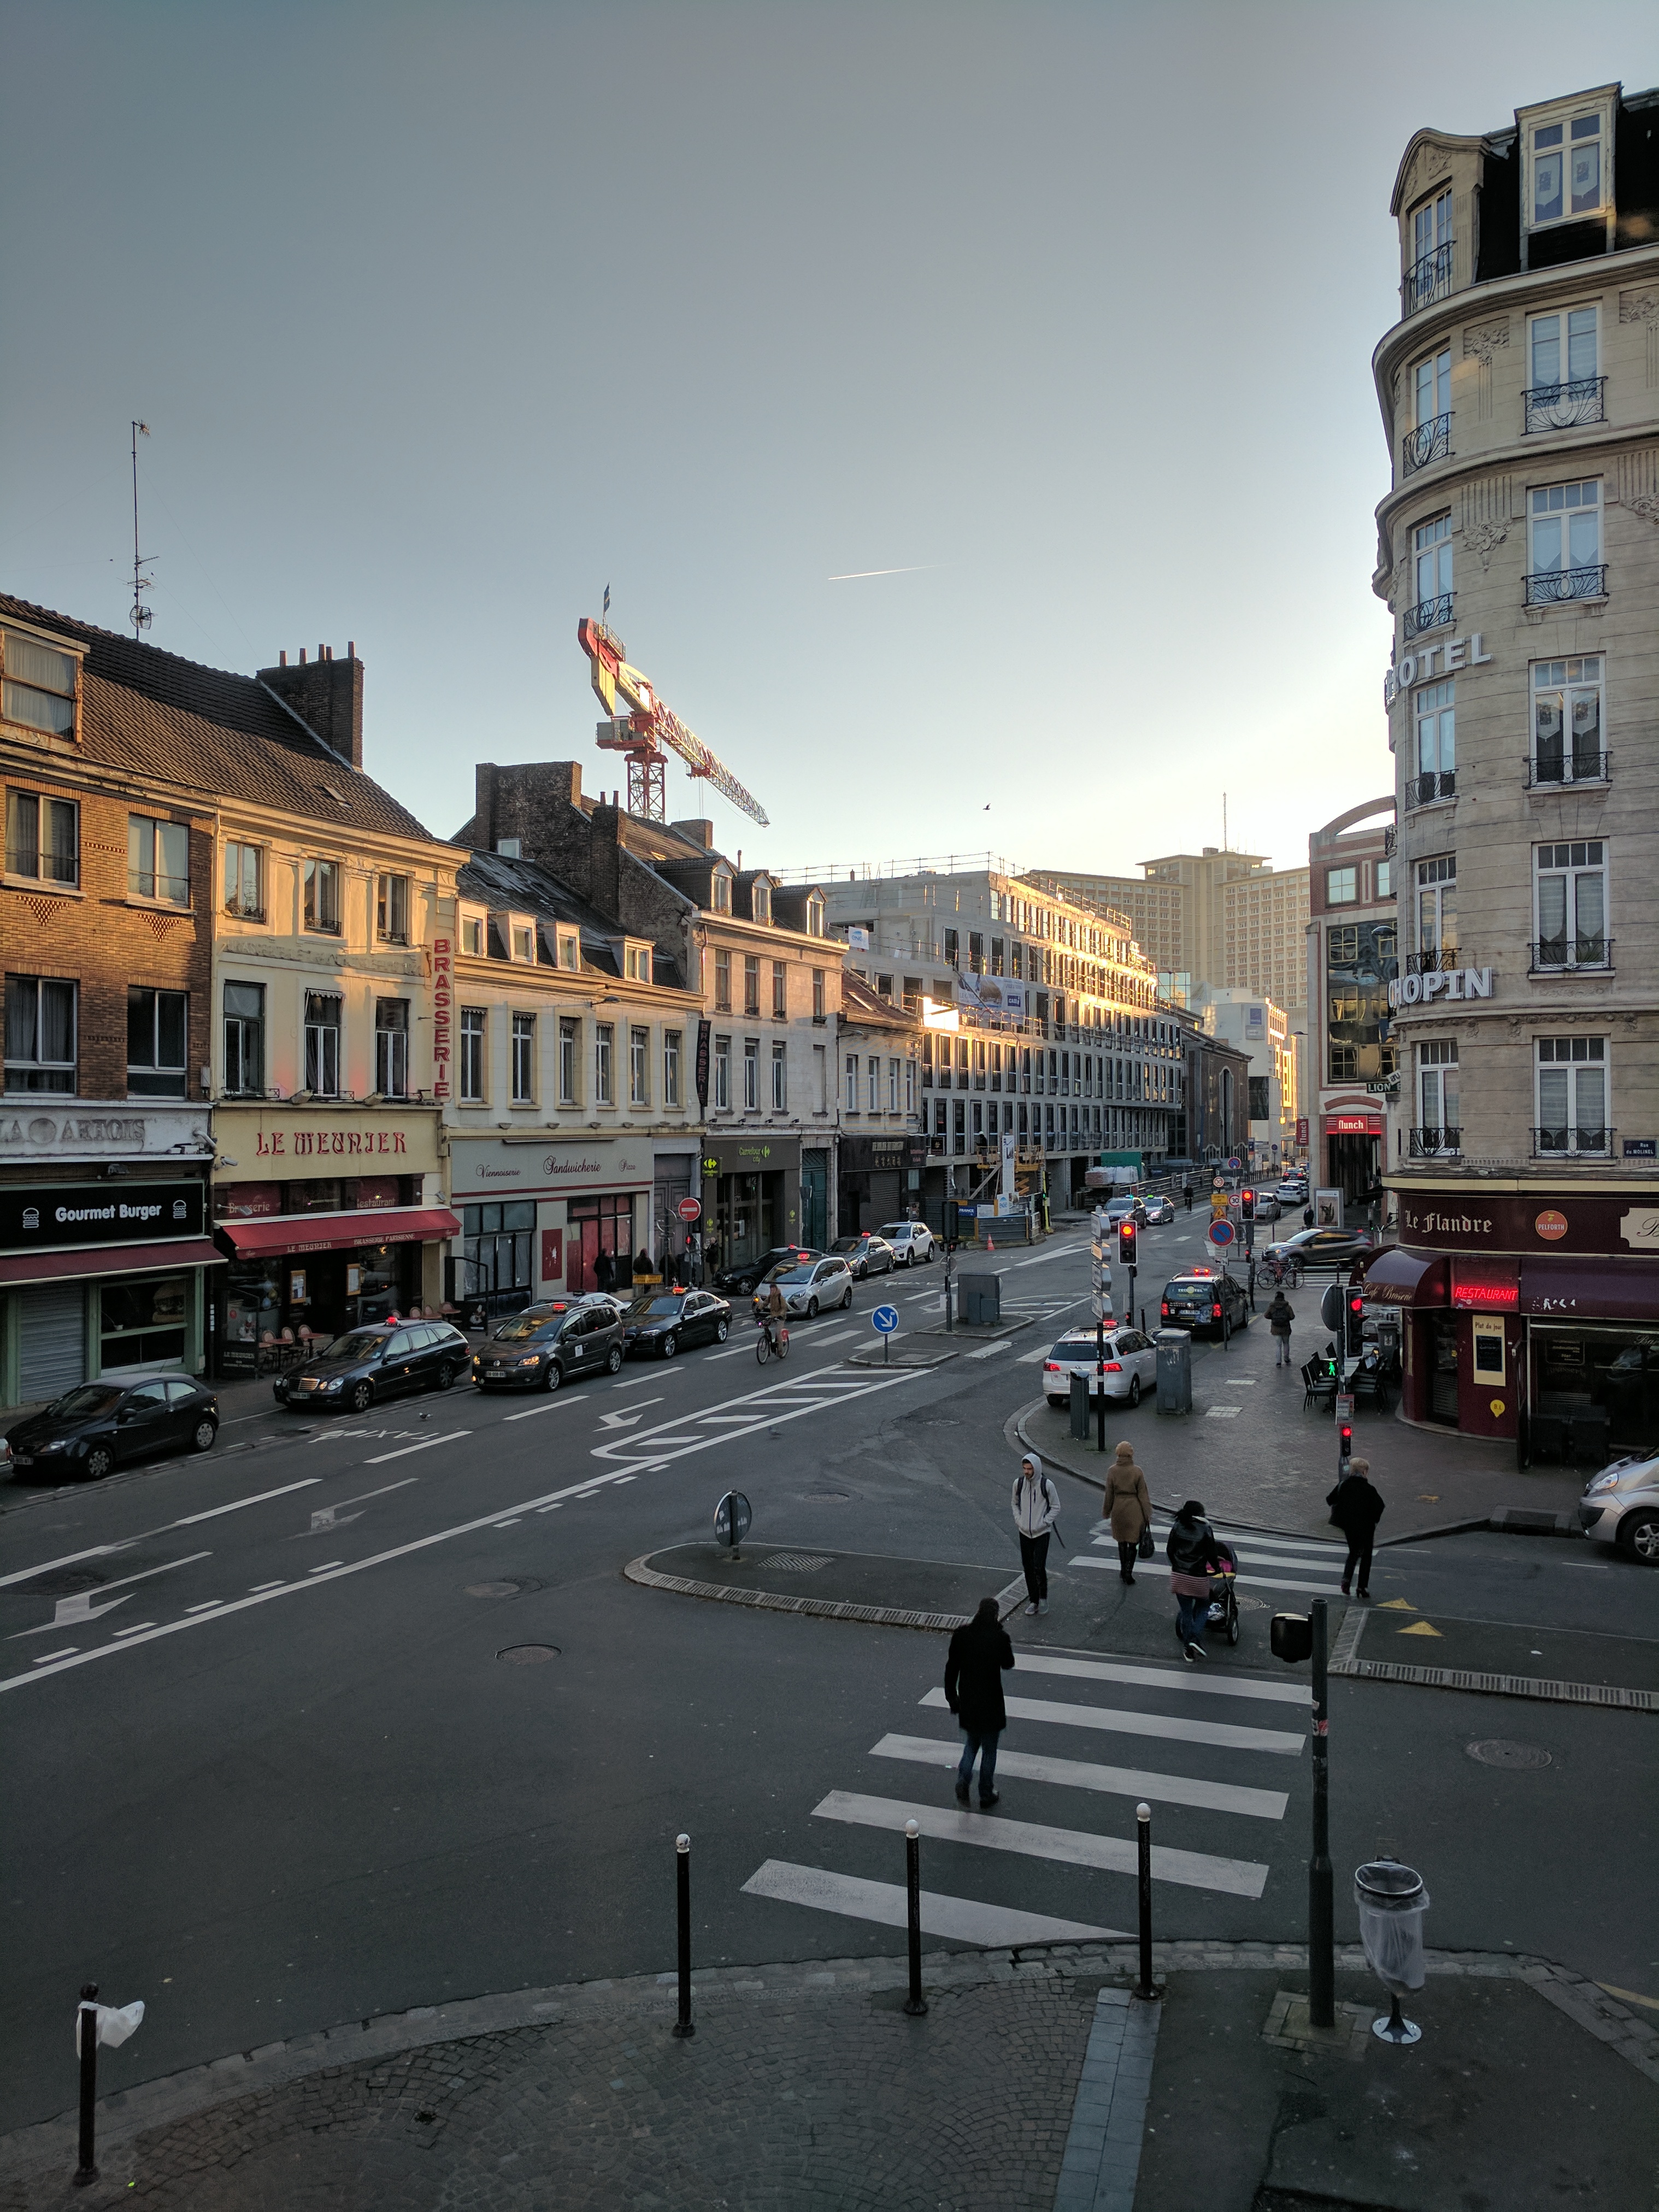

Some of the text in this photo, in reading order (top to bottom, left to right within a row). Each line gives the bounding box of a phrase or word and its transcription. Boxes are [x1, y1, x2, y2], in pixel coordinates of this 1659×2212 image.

[1386, 633, 1493, 698] HOTEL
[1388, 967, 1492, 1008] CHOPIN
[434, 938, 451, 1097] BRASSERIE
[698, 1023, 708, 1098] BRASSERIE
[1368, 1083, 1391, 1092] LION
[1299, 1121, 1308, 1144] flunch
[1338, 1120, 1364, 1129] flunch
[256, 1131, 408, 1156] LE MEUNIER
[739, 1147, 760, 1156] Carrefour
[476, 1164, 521, 1179] Viennoiserie
[543, 1155, 601, 1175] Sandwicherie
[55, 1204, 162, 1222] Gourmet Burger
[1404, 1210, 1493, 1234] Le Flandre
[287, 1242, 332, 1253] LE MEUNIER
[354, 1233, 415, 1245] BRASSERIE PARISIENNE
[1455, 1286, 1519, 1301] RESTAURANT
